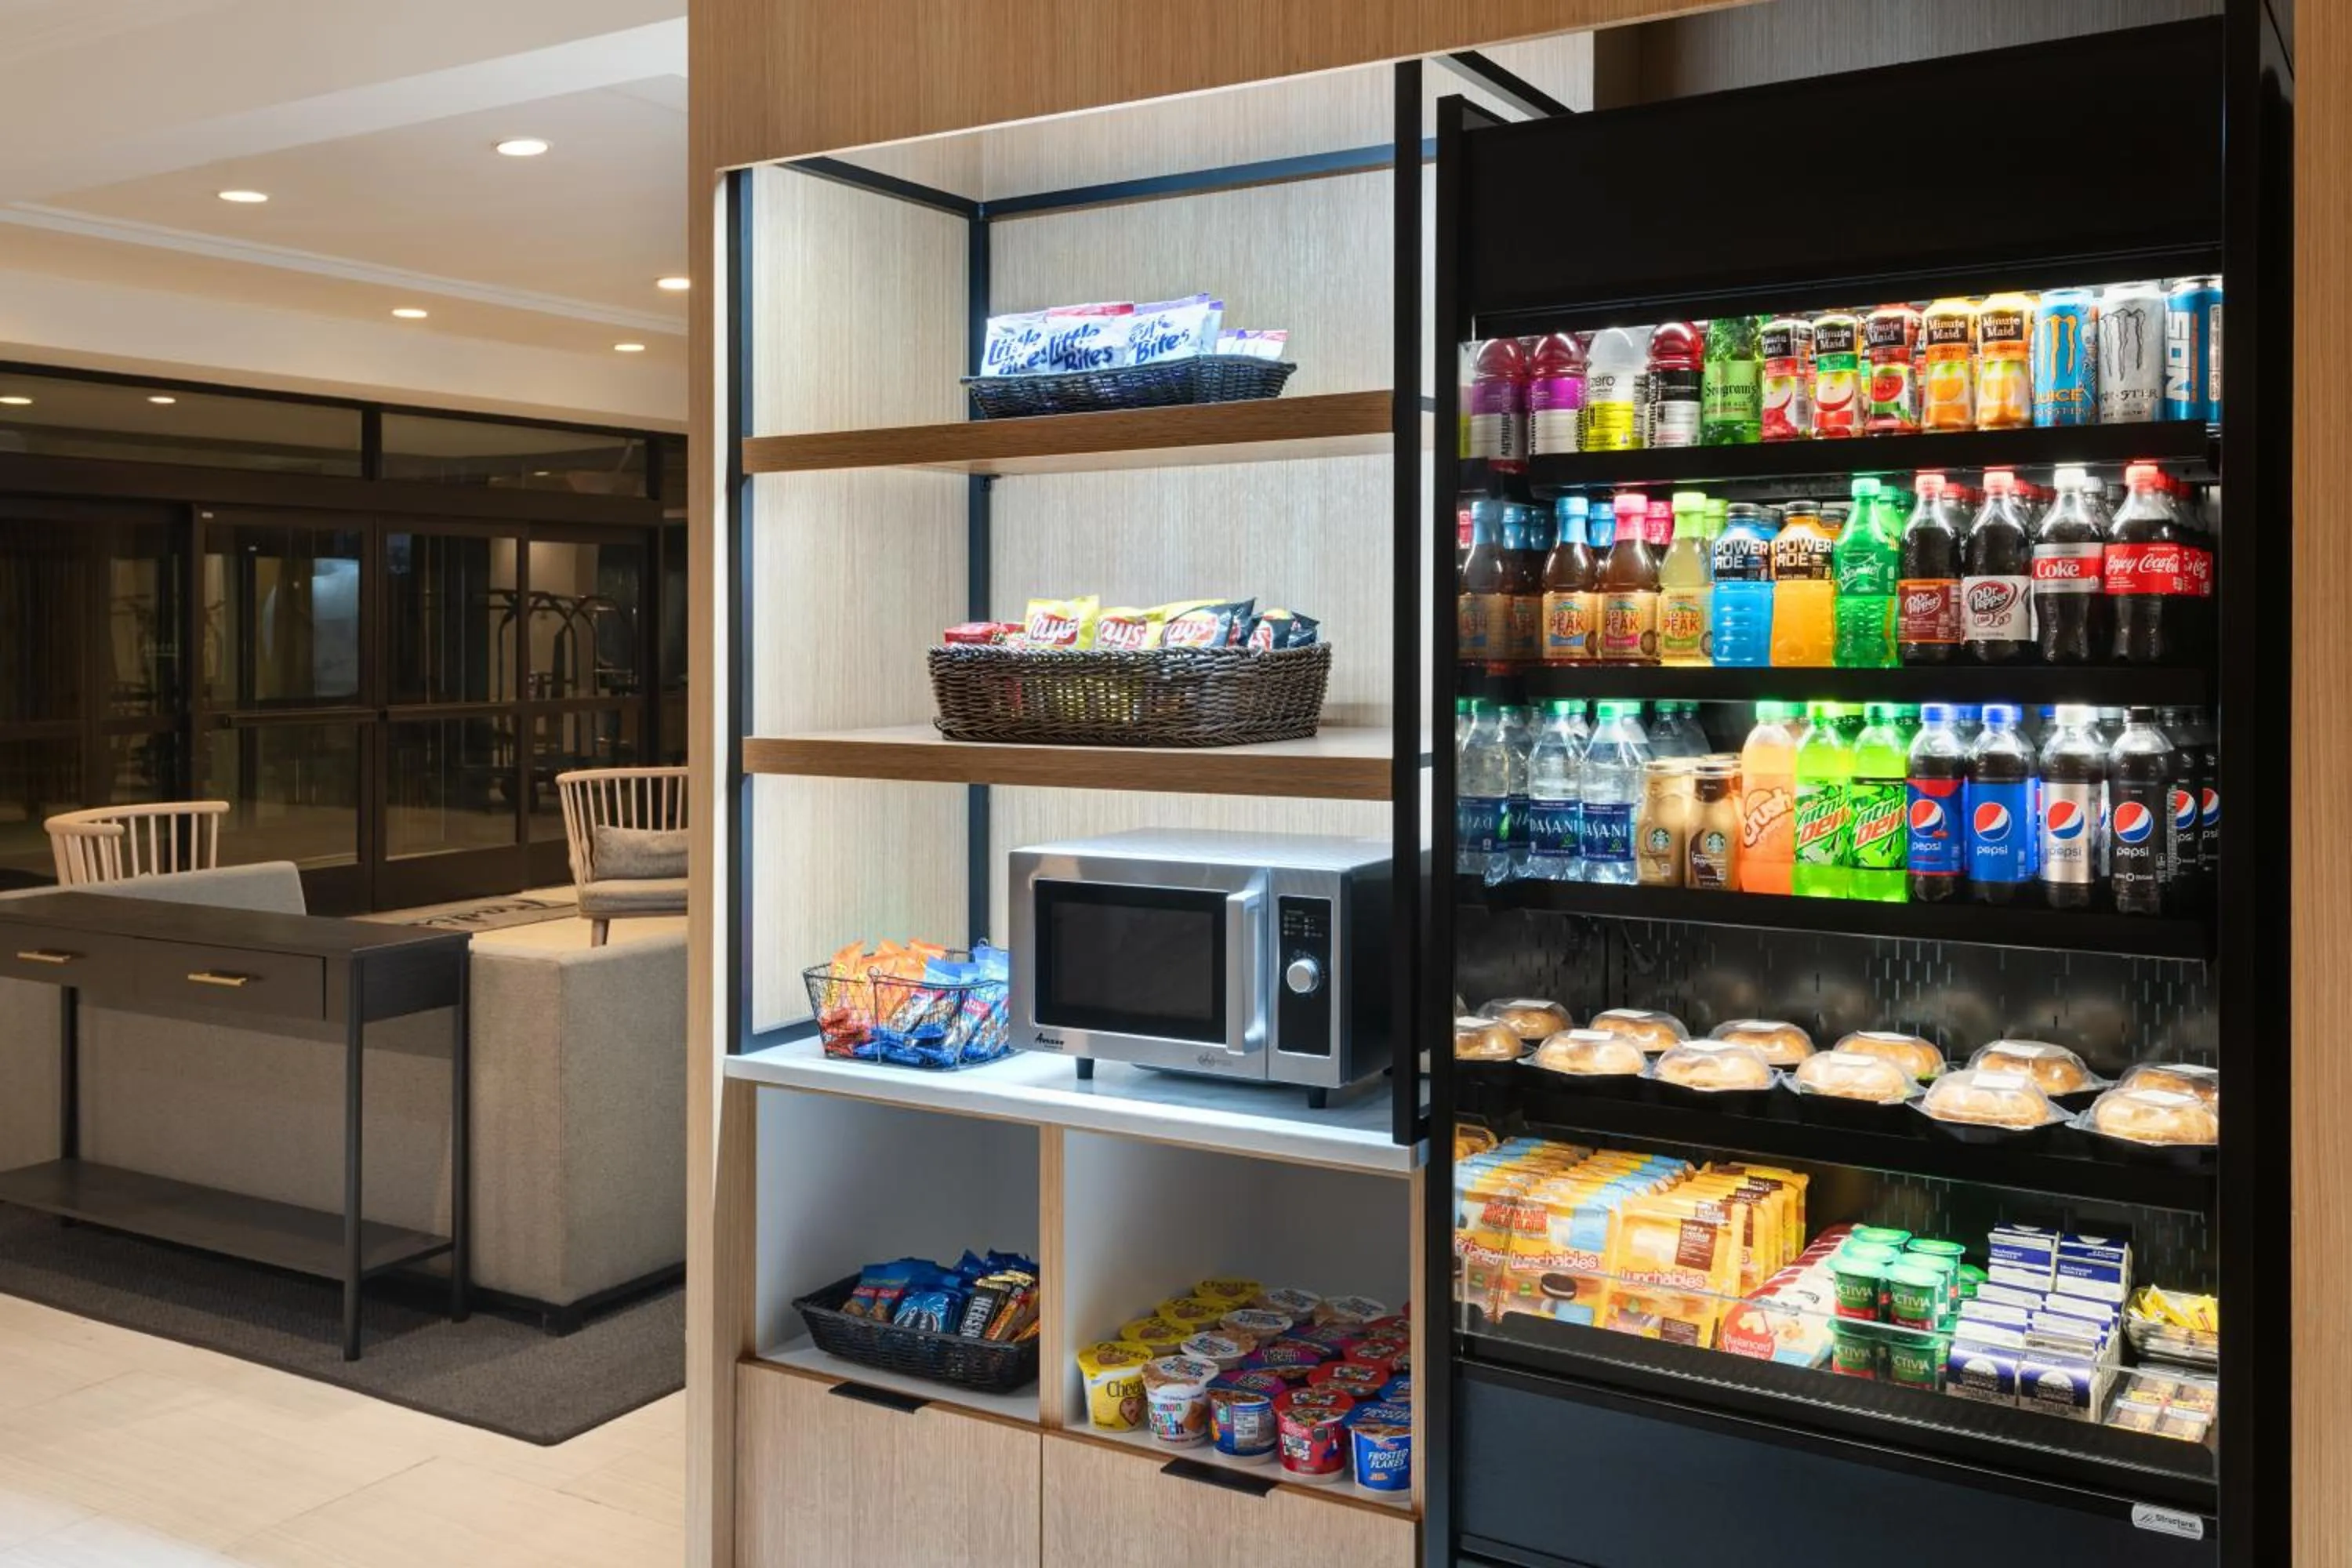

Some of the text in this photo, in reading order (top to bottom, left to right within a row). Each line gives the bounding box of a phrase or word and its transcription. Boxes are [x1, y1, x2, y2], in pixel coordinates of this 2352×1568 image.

[1929, 319, 1965, 329] Minute
[1984, 316, 2020, 327] Minute
[1933, 328, 1961, 340] Maid
[1987, 325, 2016, 337] Maid
[2166, 311, 2190, 401] NOS
[1715, 541, 1769, 555] POWER
[1777, 539, 1832, 553] POWER
[2037, 560, 2080, 578] Coke
[1549, 618, 1584, 630] PEAK
[1605, 618, 1639, 630] PEAK
[1663, 619, 1699, 631] PEAK
[1530, 817, 1577, 837] DASANI
[1912, 841, 1942, 852] pepsi
[1976, 844, 2009, 856] pepsi
[2116, 846, 2150, 859] pepsi
[1510, 1250, 1599, 1270] lunchables
[1620, 1267, 1707, 1289] lunchables
